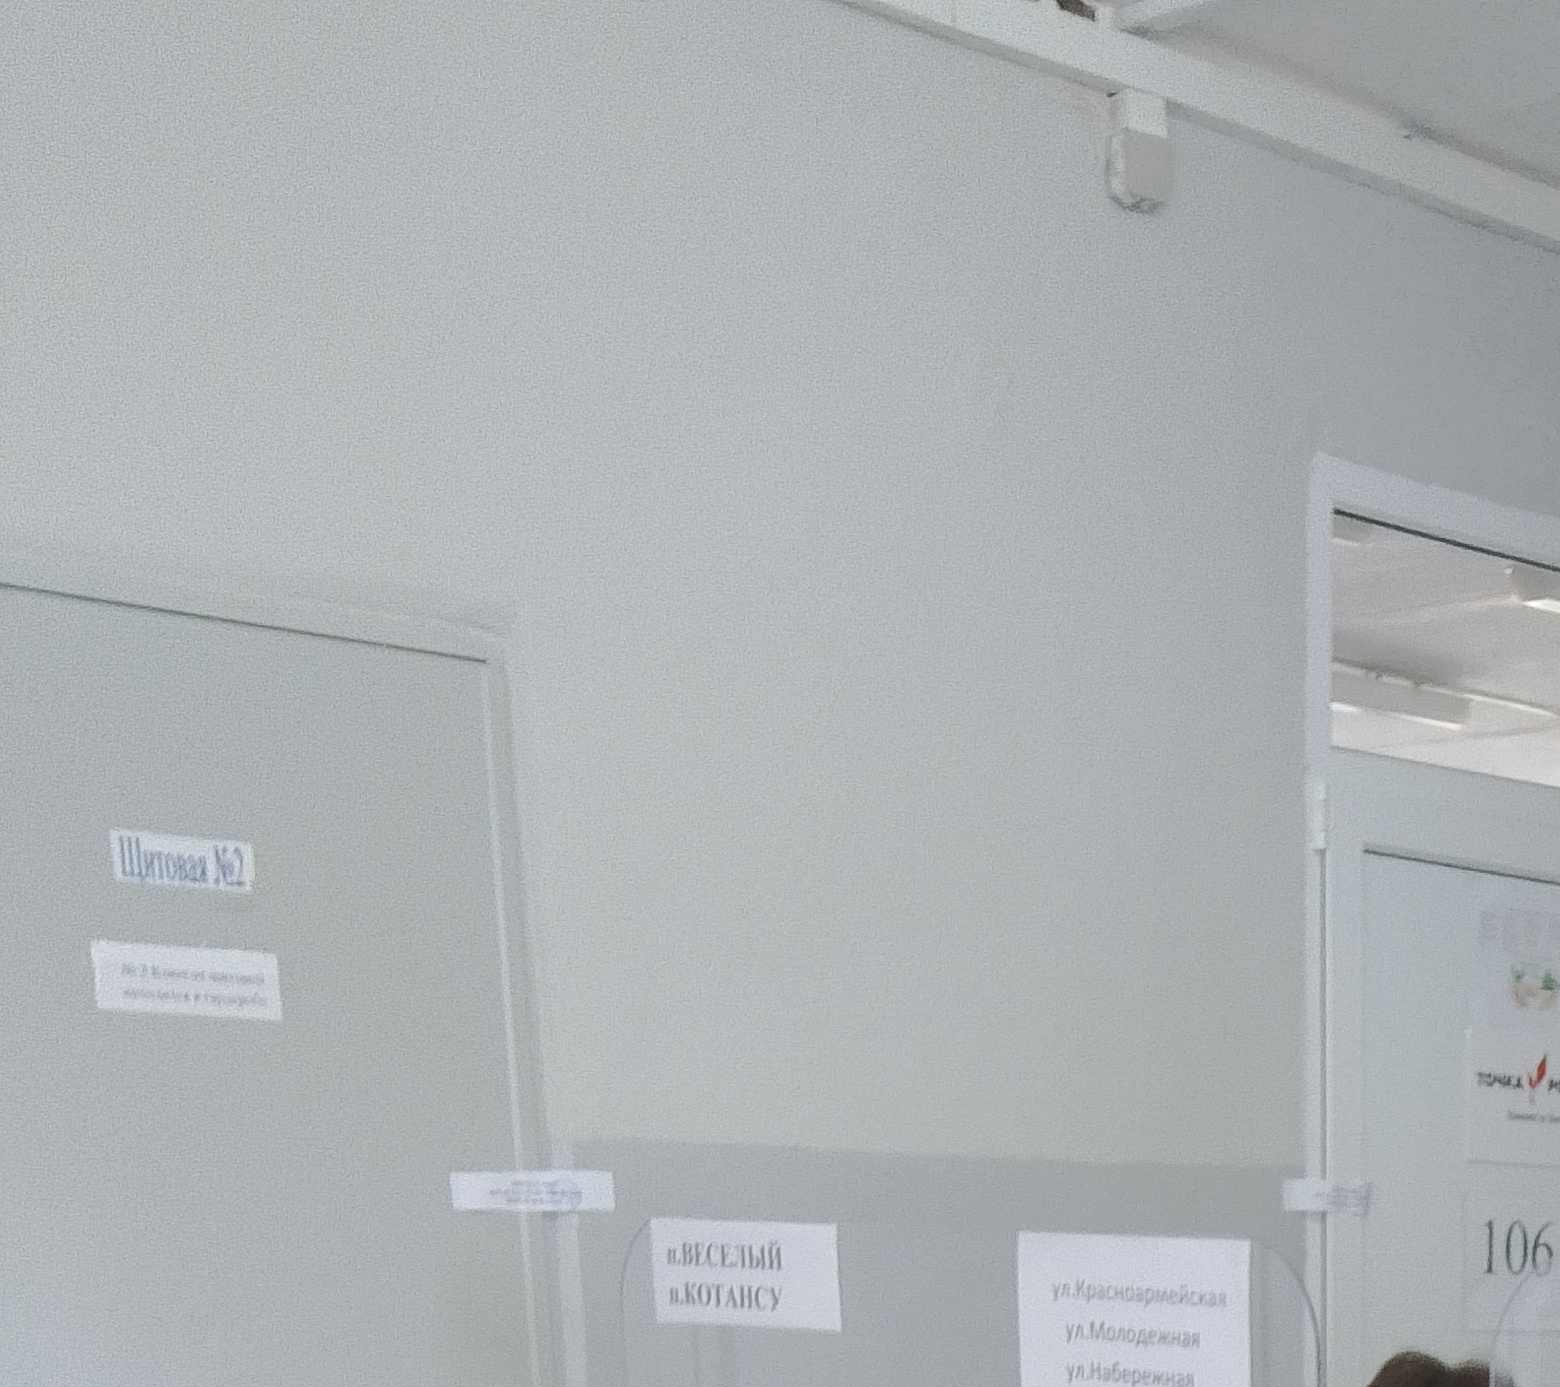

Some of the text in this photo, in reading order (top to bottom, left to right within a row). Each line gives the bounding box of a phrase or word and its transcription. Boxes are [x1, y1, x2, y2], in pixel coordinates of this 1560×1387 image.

[1483, 1219, 1554, 1276] 106
[669, 1281, 783, 1312] п.КОТАНСУ
[1052, 1278, 1228, 1308] ул.Красноармейская
[1065, 1320, 1200, 1348] ул.Молодежная
